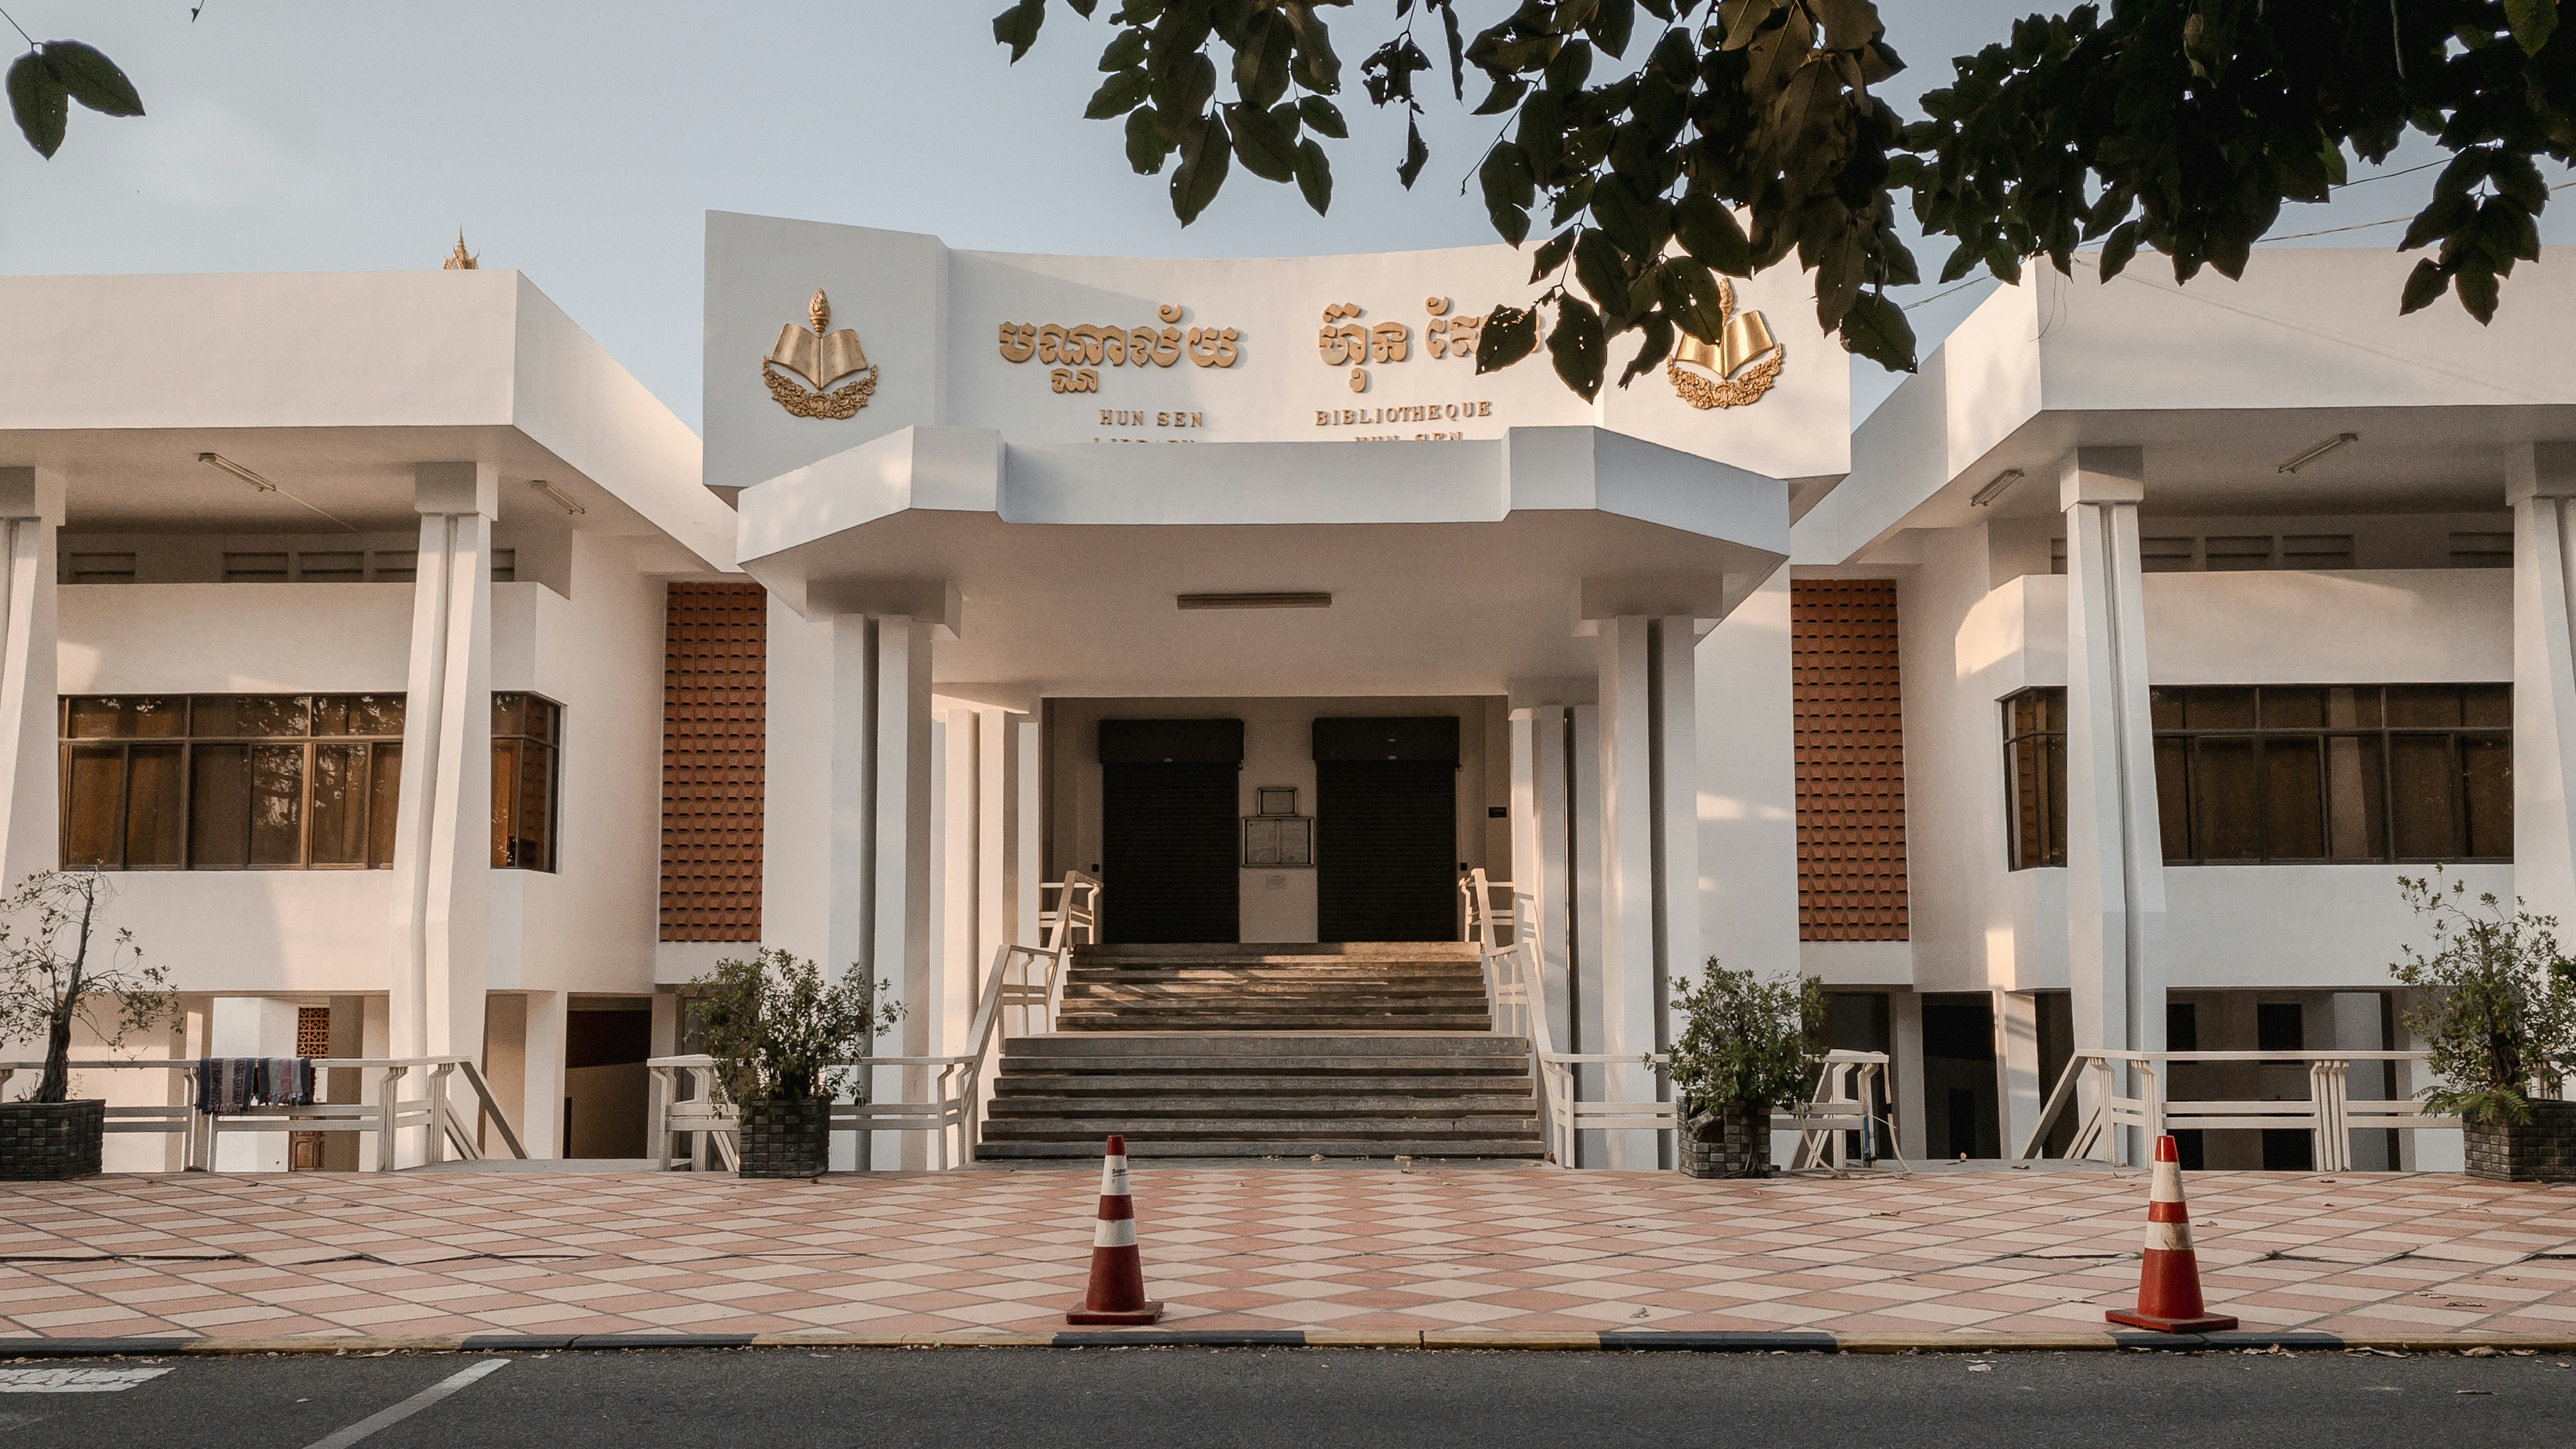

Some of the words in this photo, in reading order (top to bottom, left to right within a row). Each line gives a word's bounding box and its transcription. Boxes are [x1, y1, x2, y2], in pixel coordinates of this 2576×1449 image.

[1099, 408, 1144, 426] HUN
[1156, 411, 1203, 428] SEN
[1314, 400, 1491, 426] BIBLIOTHEQUE
